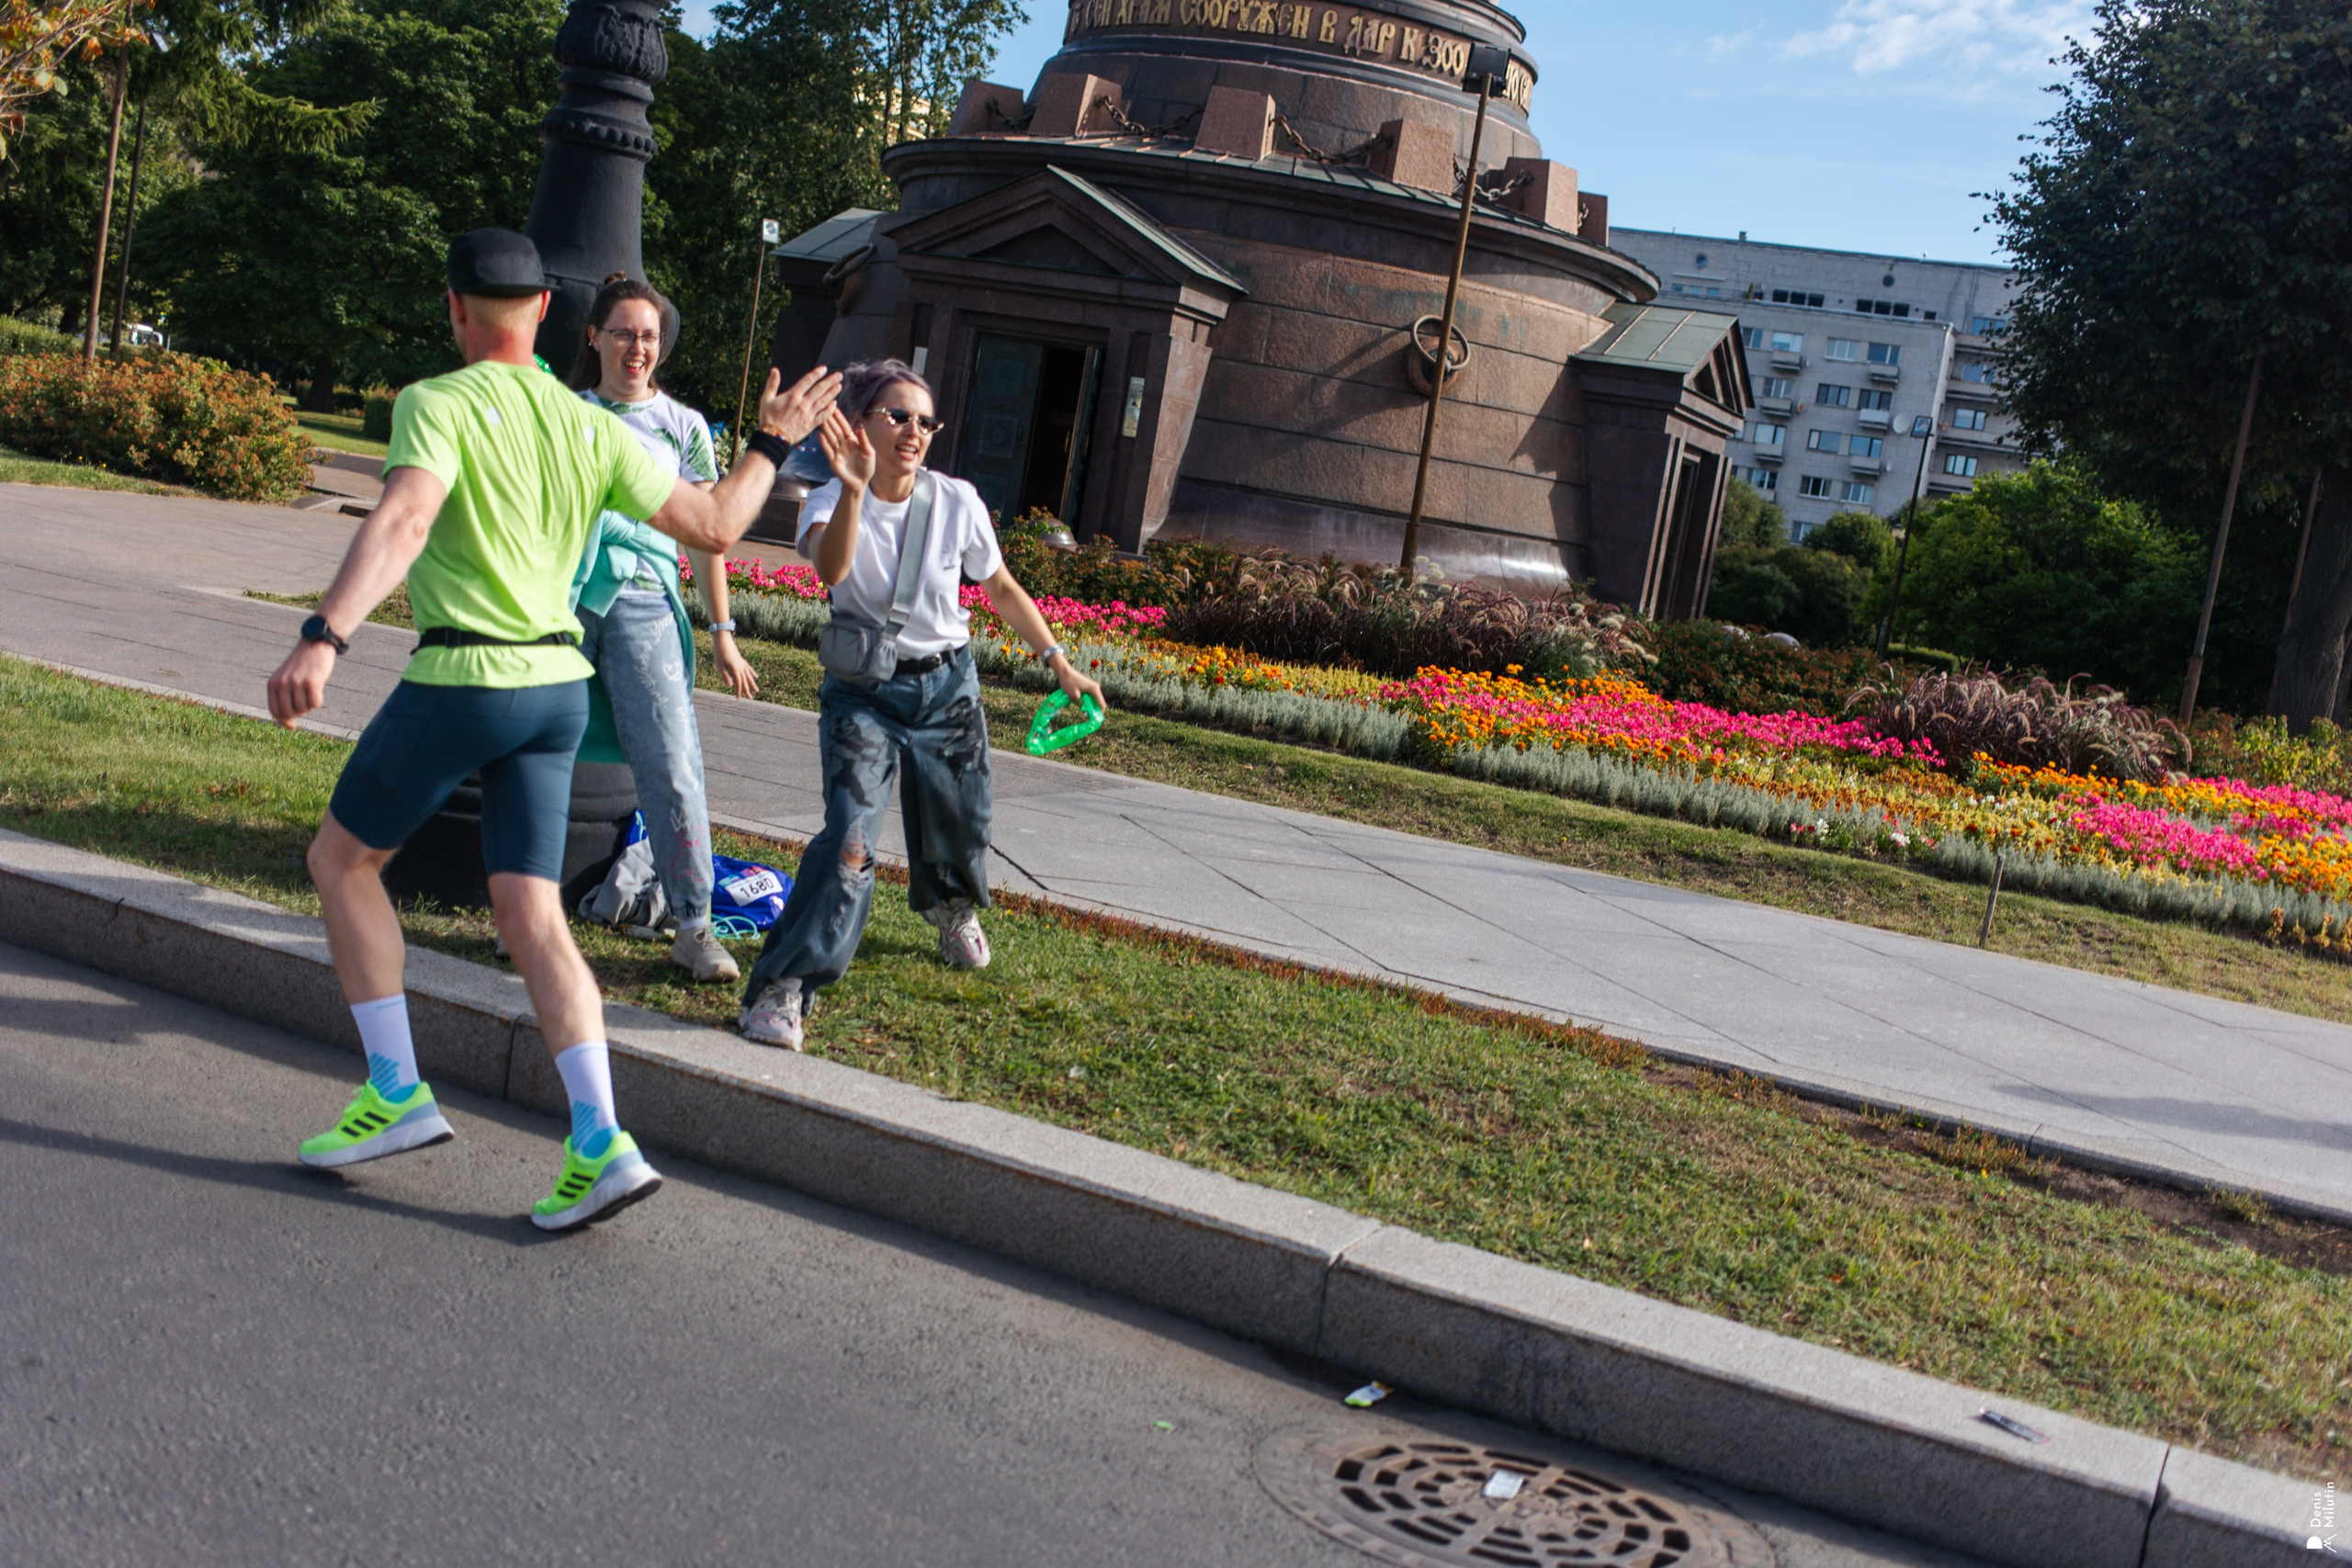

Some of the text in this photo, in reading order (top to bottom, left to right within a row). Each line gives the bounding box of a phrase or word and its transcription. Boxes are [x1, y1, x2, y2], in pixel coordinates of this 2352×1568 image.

[1179, 0, 1312, 39] СООРУЖЕН
[1318, 9, 1339, 44] В
[1343, 15, 1396, 57] ДАР
[1399, 26, 1419, 62] К
[740, 878, 775, 898] 1680
